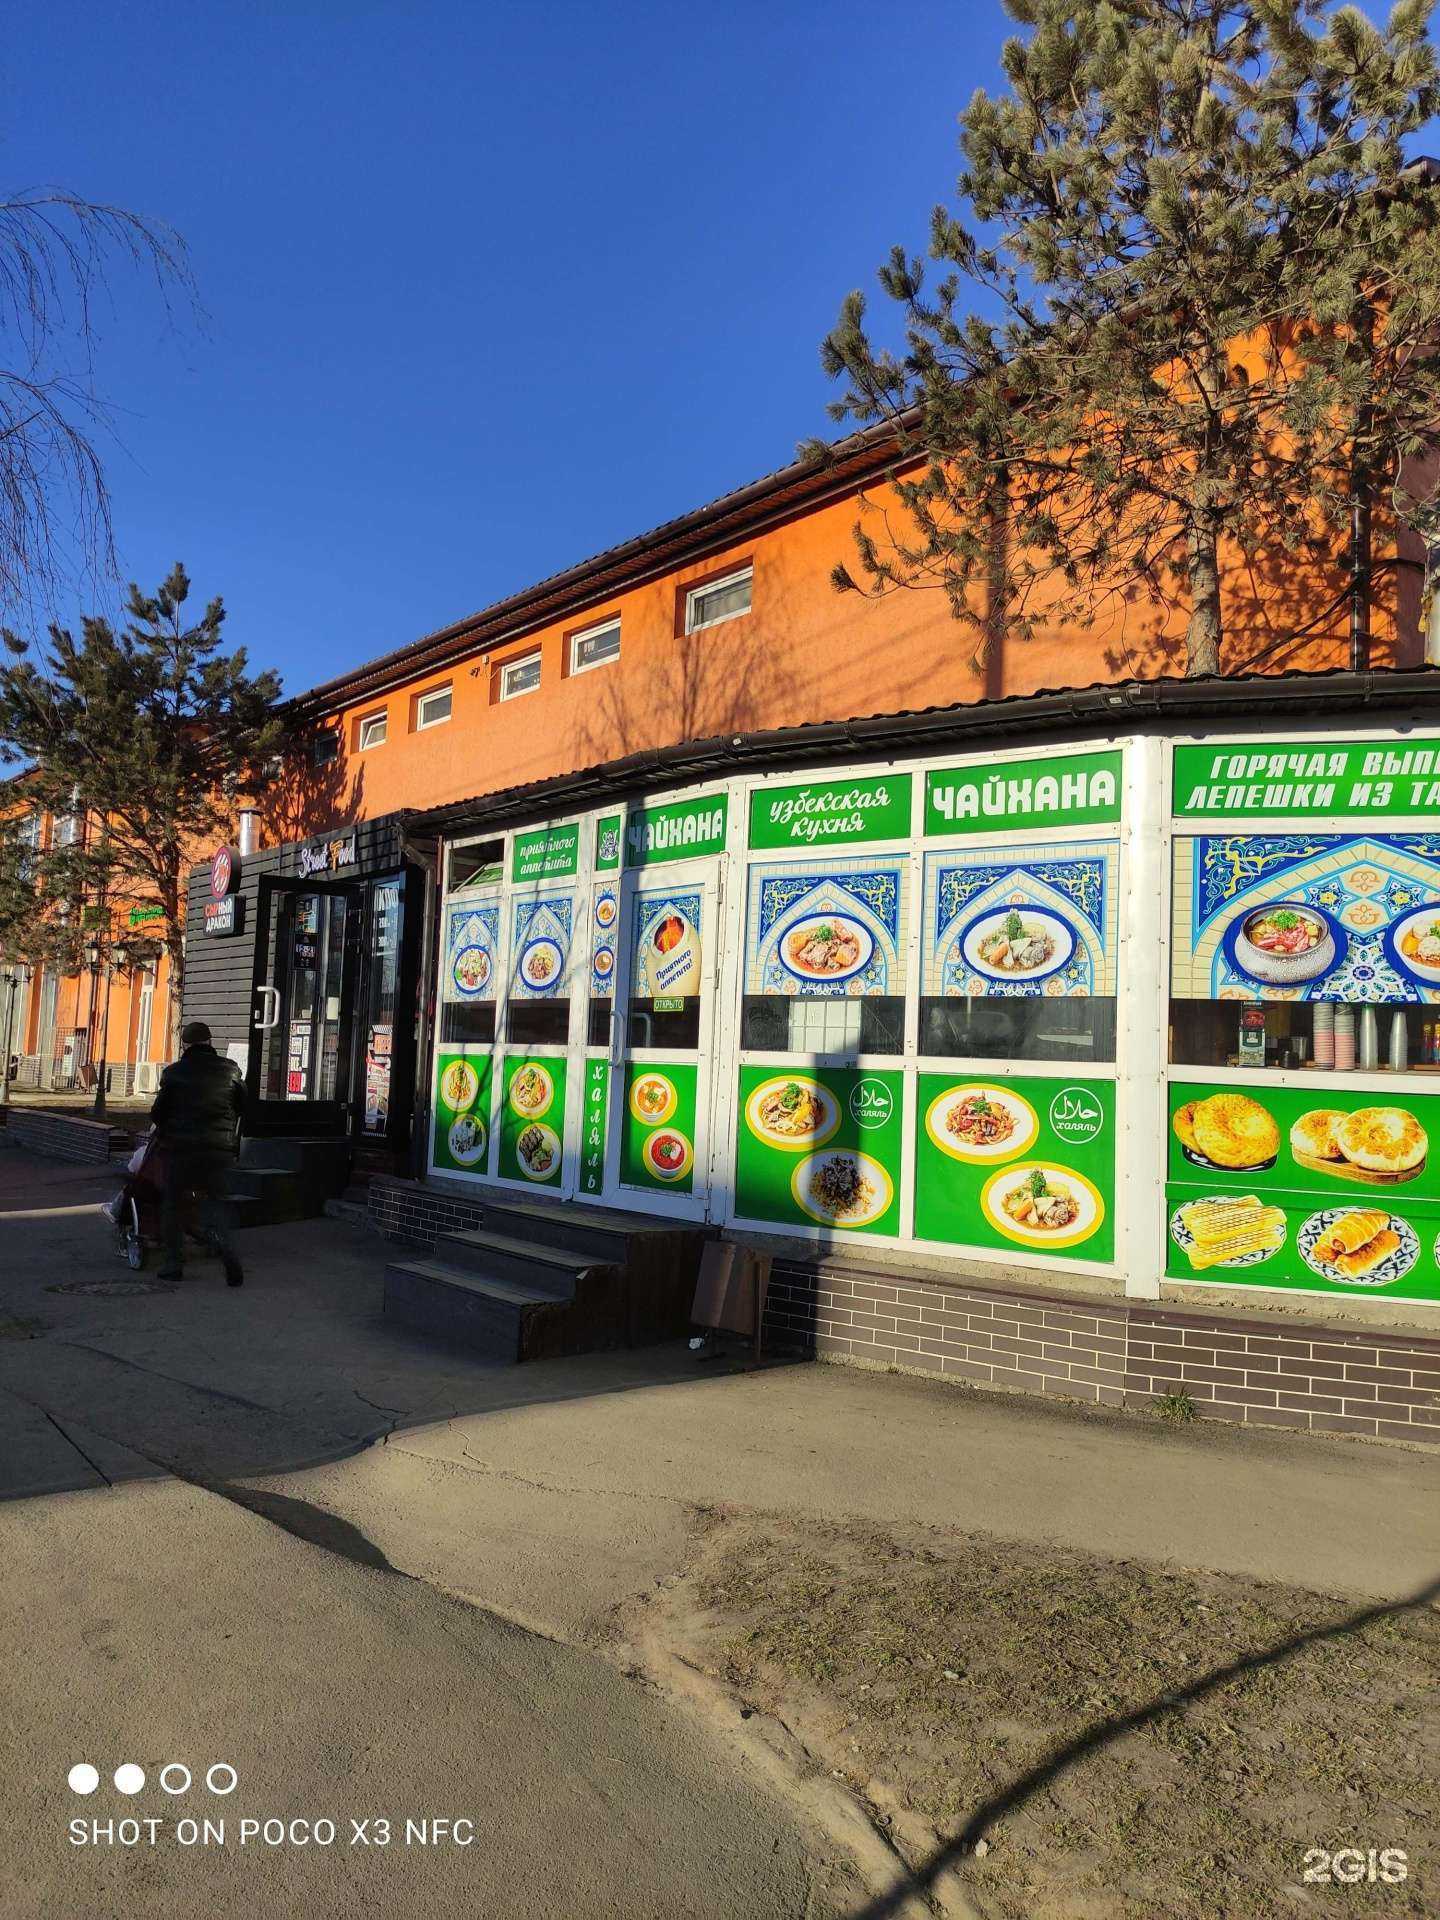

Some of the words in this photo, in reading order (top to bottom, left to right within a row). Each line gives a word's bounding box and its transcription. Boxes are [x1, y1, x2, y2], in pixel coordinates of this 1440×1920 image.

[1210, 752, 1348, 779] ГОРЯЧАЯ
[1362, 750, 1440, 776] ВЫП
[933, 770, 1116, 820] ЧАЙХАНА
[1184, 783, 1336, 809] ЛЕПЕШКИ
[1348, 782, 1394, 807] ИЗ
[628, 808, 723, 853] ЧАЙХАНА
[299, 842, 328, 879] Street
[330, 833, 356, 872] Food
[206, 914, 231, 933] ДРАКОН
[655, 949, 692, 981] Приятного
[660, 958, 693, 991] аппетита!
[655, 999, 683, 1009] ОТКРЫТО
[855, 1108, 888, 1119] халяль
[1054, 1095, 1099, 1119] حلال
[1056, 1121, 1097, 1132] халяль
